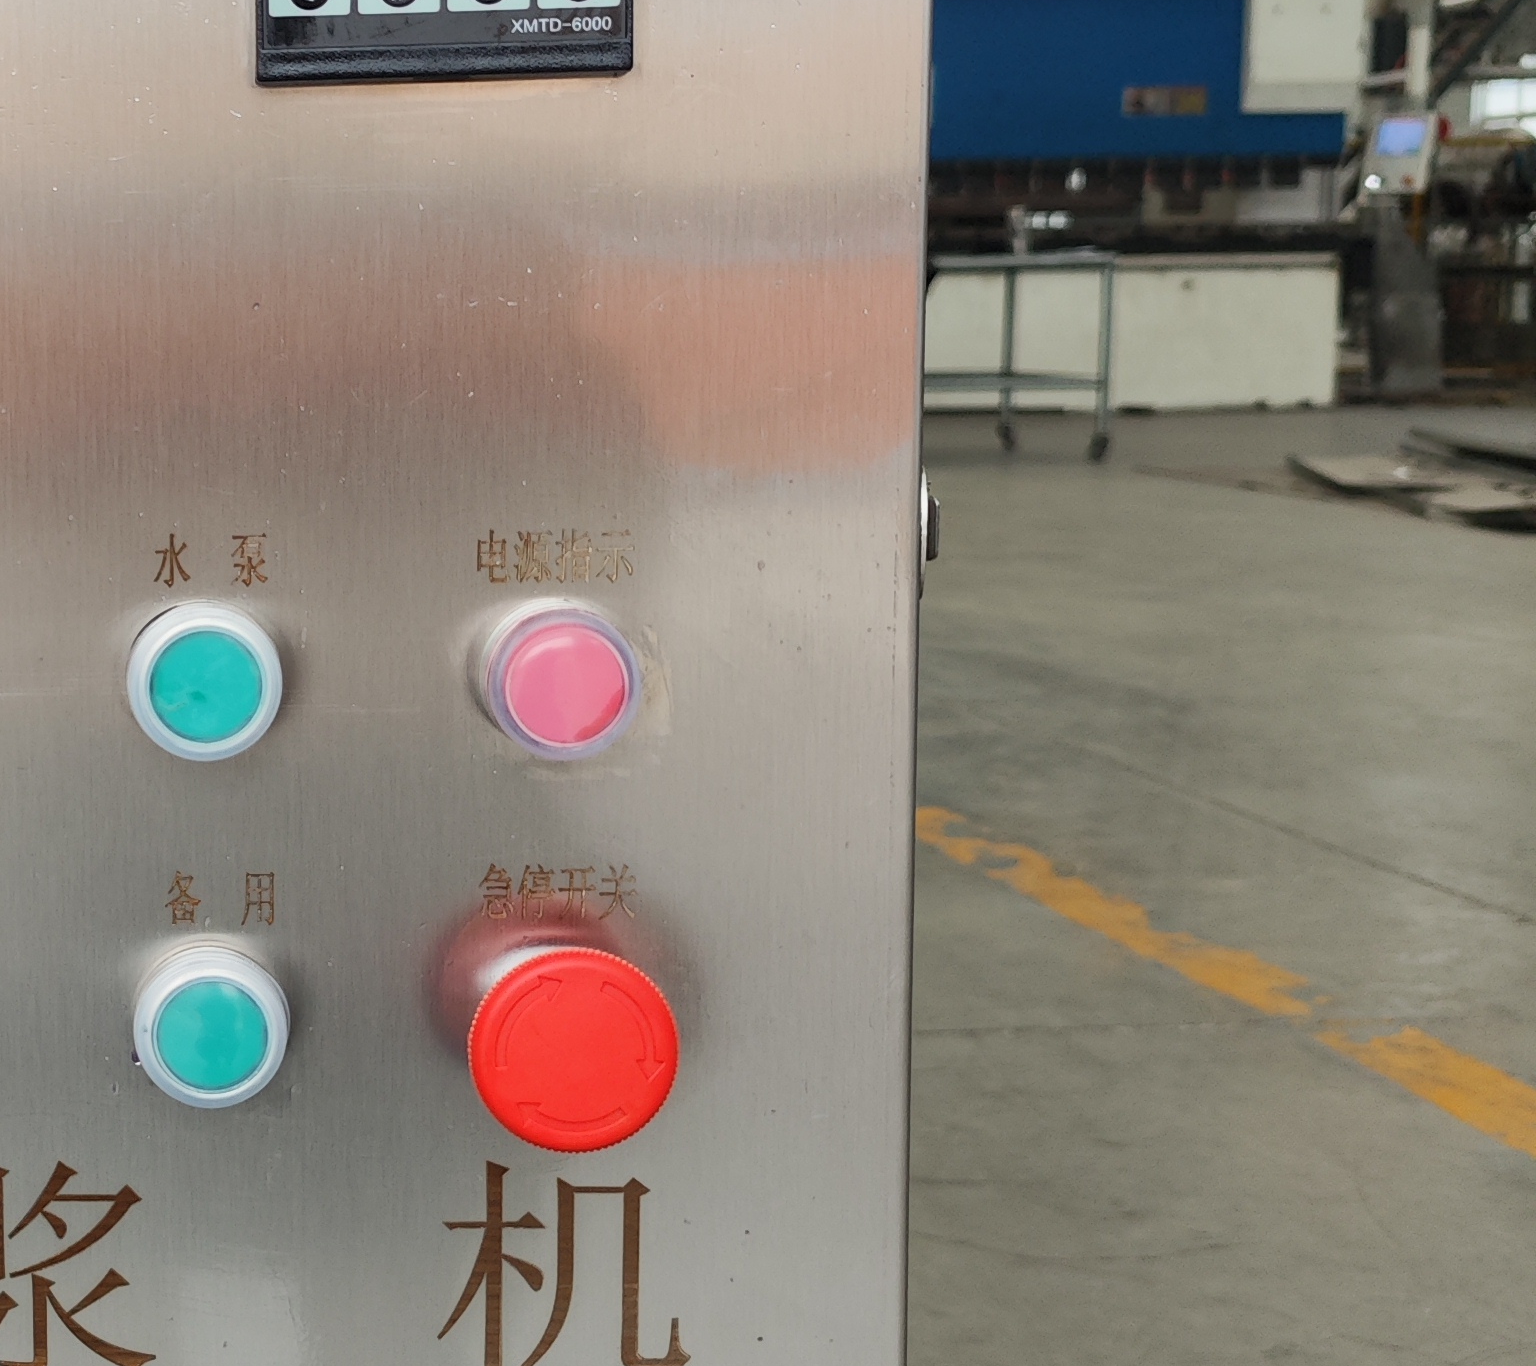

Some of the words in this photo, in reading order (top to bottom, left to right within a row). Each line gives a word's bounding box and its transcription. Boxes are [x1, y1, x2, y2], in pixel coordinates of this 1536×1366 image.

[510, 16, 613, 35] XMTD-6000
[476, 528, 636, 584] 电源指示
[478, 863, 639, 922] 急停开关
